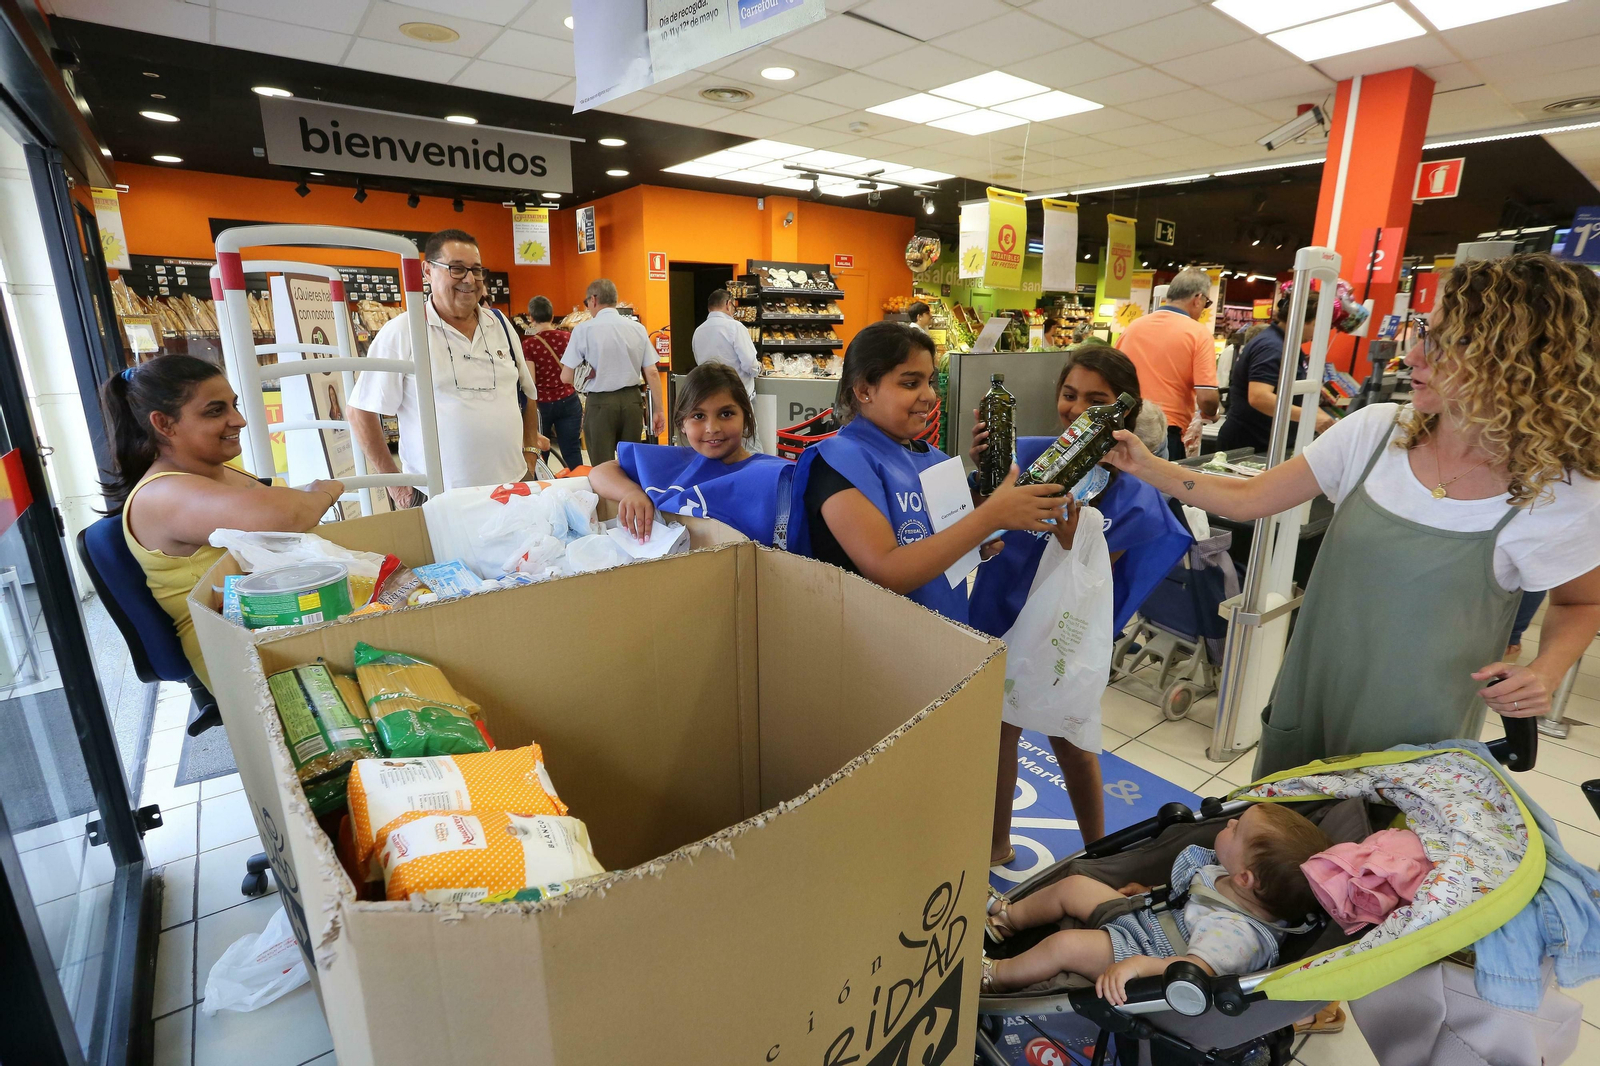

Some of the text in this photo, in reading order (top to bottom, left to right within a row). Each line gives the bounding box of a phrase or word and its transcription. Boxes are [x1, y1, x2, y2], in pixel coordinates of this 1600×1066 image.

[659, 15, 669, 28] Día
[670, 11, 678, 23] de
[690, 16, 699, 28] de
[699, 8, 719, 26] mayo
[298, 116, 549, 177] bienvenidos
[1366, 249, 1385, 275] 2
[294, 286, 322, 302] ¿Quieres
[1419, 287, 1427, 304] 1
[299, 309, 311, 320] con
[941, 508, 959, 520] Carrefour
